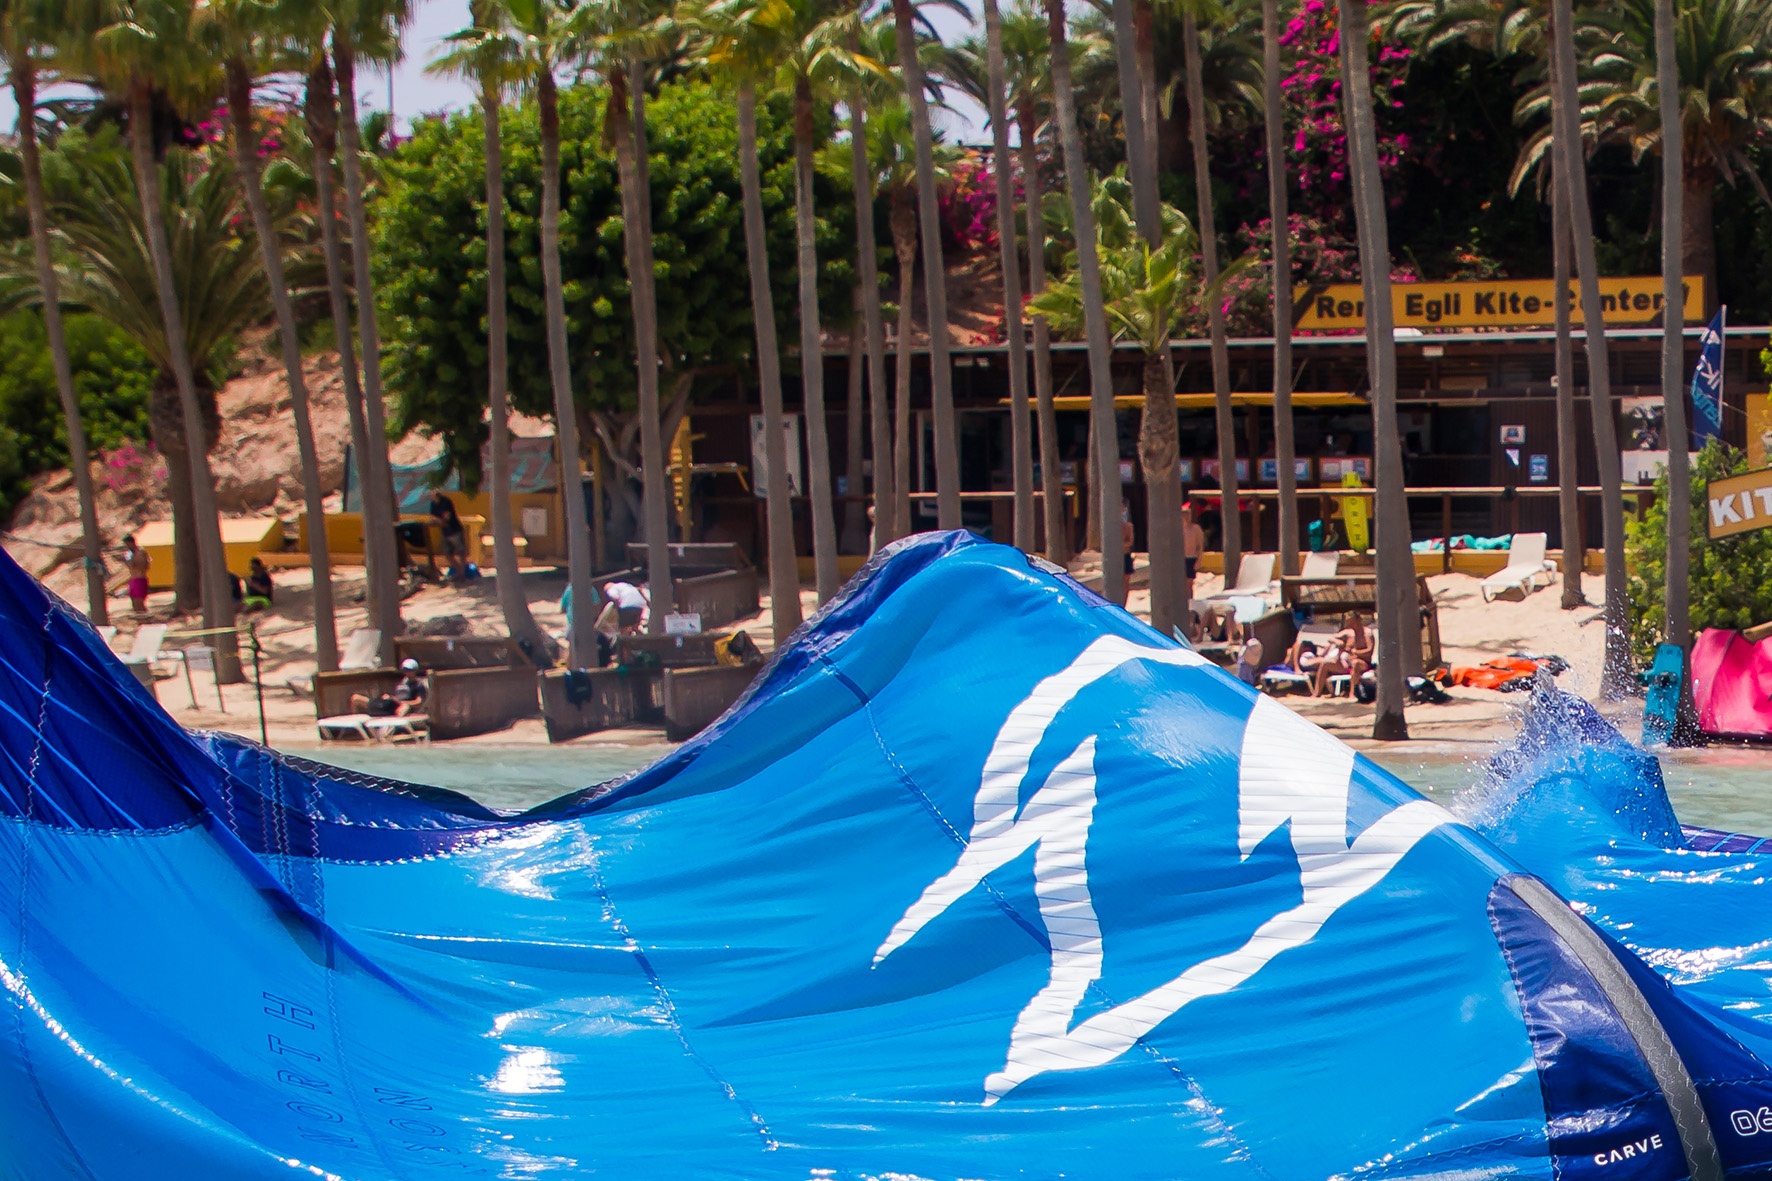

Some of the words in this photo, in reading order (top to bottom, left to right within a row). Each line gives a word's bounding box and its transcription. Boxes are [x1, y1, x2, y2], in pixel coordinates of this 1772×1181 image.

[1405, 292, 1460, 321] Egli
[1475, 288, 1664, 315] Kite-nter
[1594, 1134, 1663, 1166] CARVE
